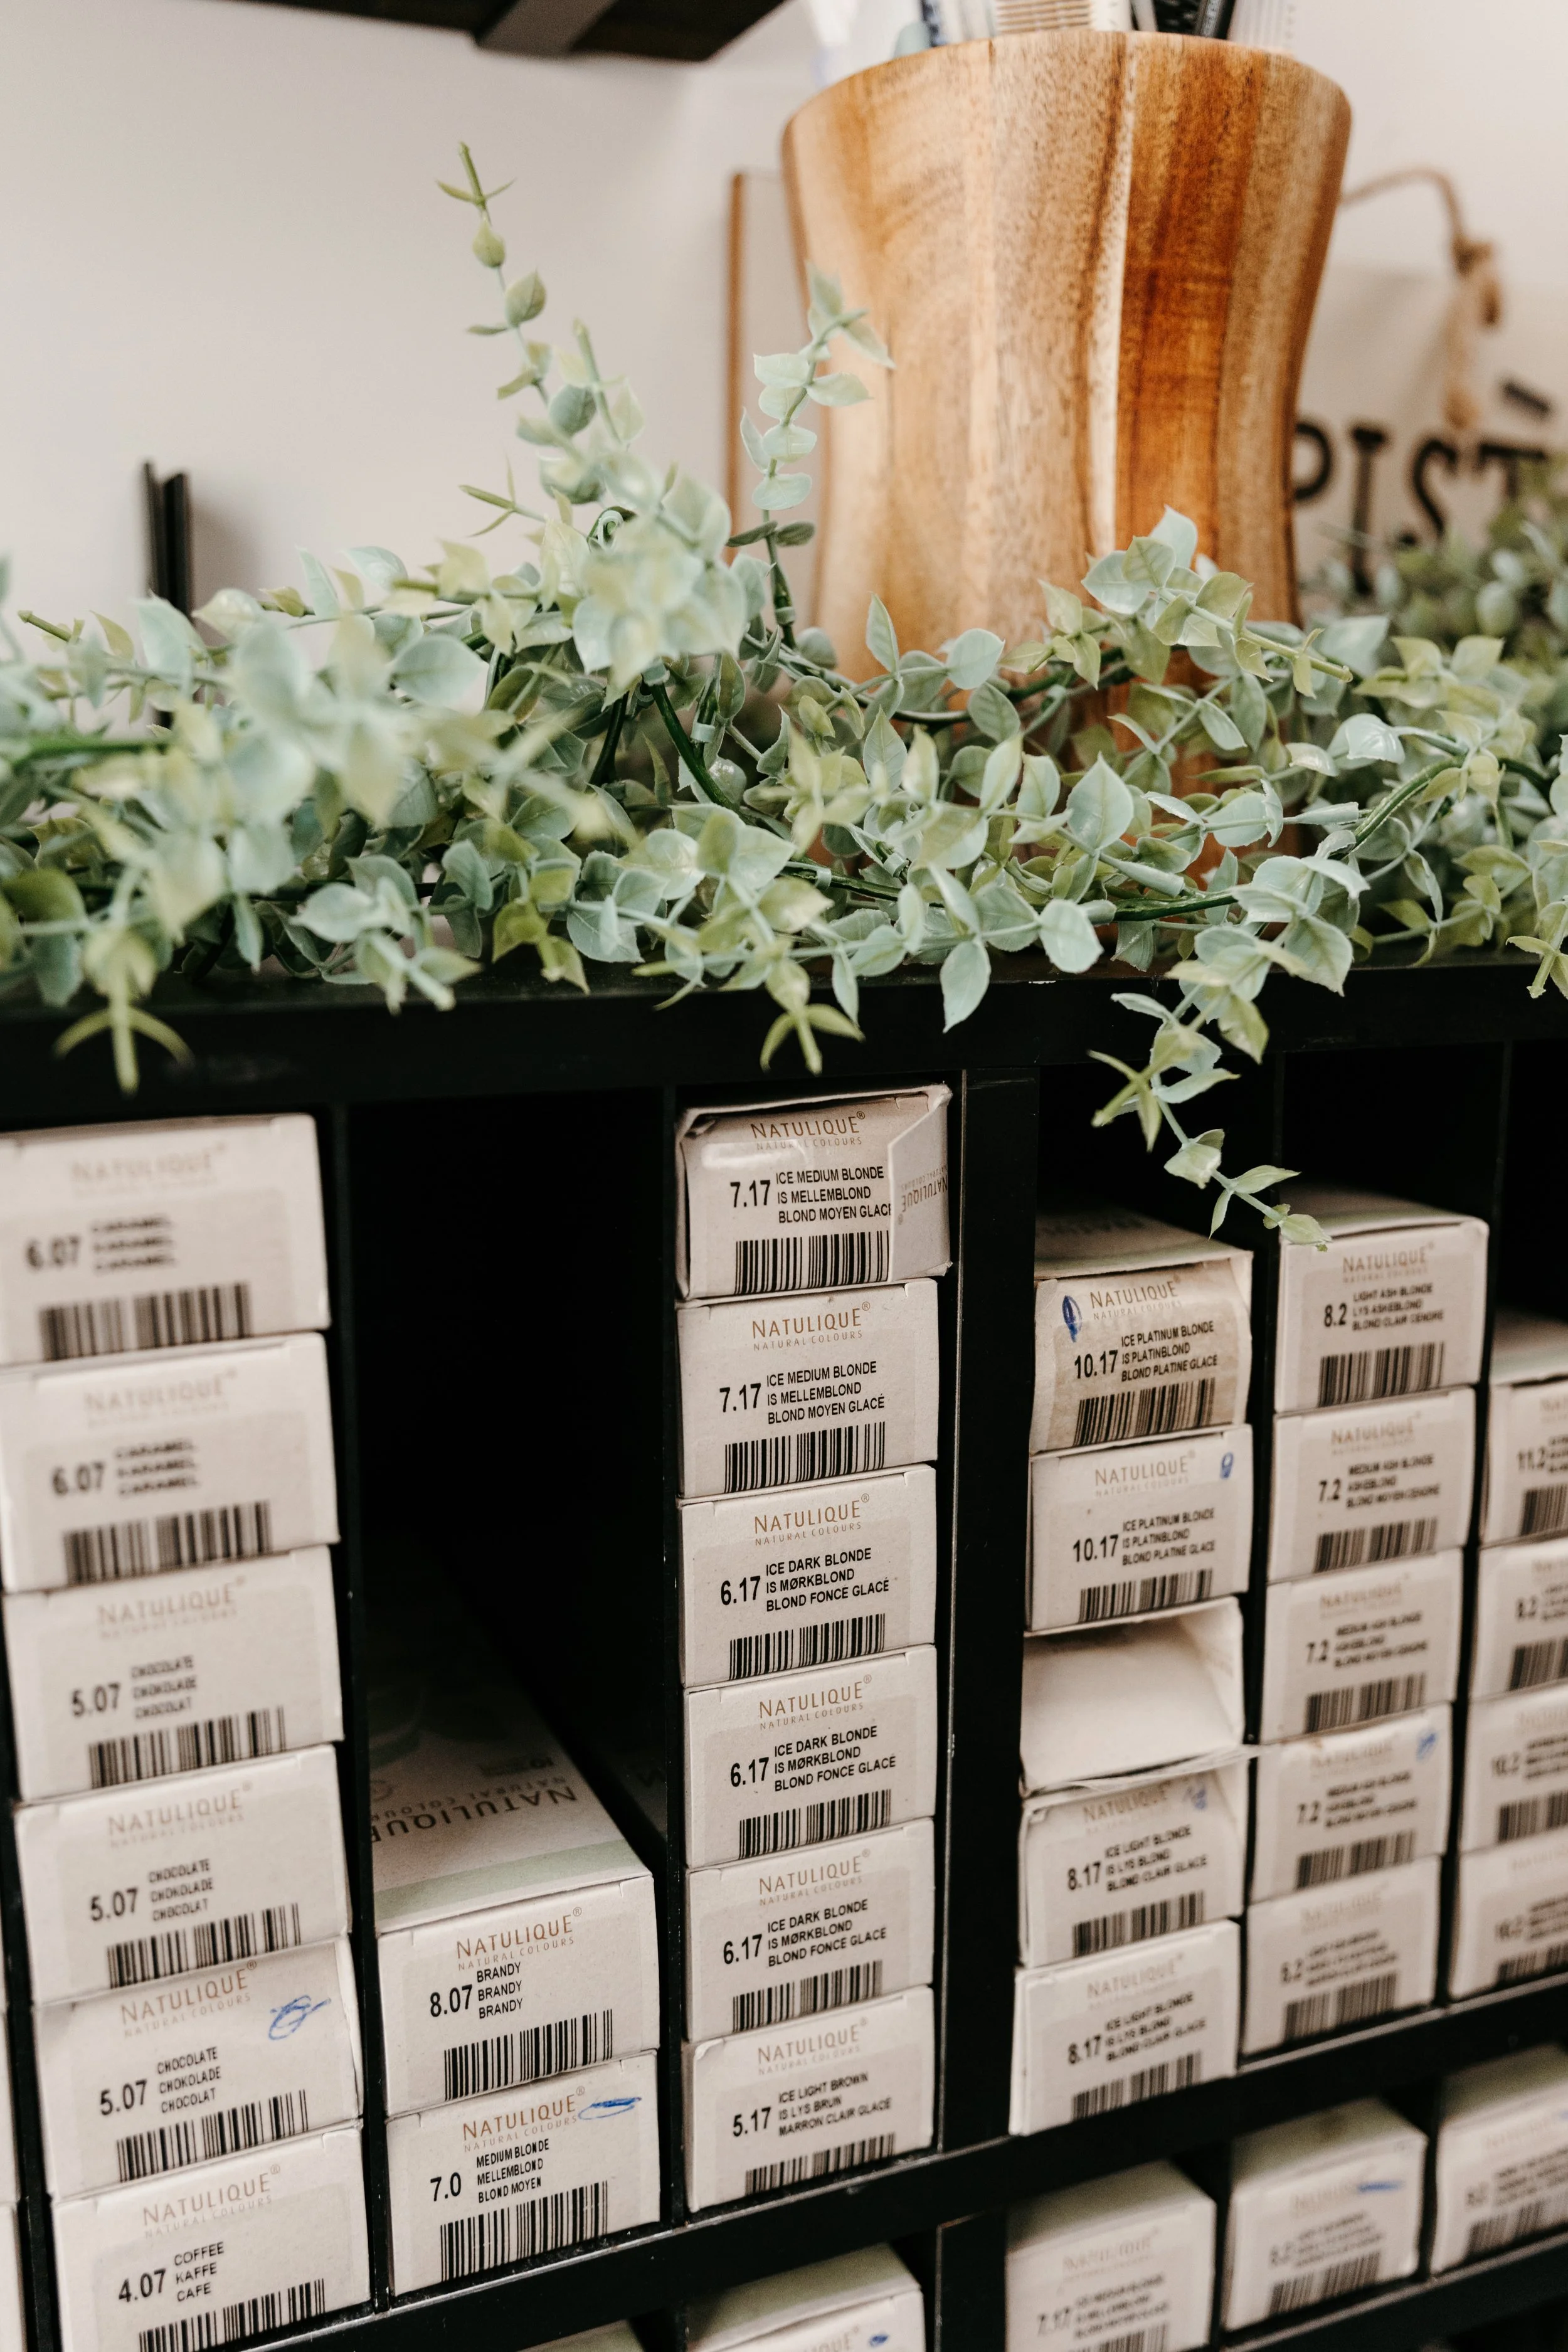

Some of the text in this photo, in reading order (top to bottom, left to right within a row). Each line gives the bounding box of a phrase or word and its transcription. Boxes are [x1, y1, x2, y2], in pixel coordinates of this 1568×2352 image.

[813, 1137, 862, 1147] COLOURS
[776, 1167, 884, 1185] ICE MEDIUM BLONDE
[730, 1180, 770, 1207] 7.17
[778, 1186, 871, 1204] IS MELLEMBLOND
[778, 1204, 890, 1223] BLOND MOYEN GLAC
[1324, 1303, 1347, 1327] 8.2
[754, 1330, 862, 1351] NATURAL COLOURS
[1121, 1321, 1214, 1347] ICE PLATINUM BLONDE
[1074, 1350, 1118, 1379] 10.17
[1123, 1342, 1190, 1364] IS PLATINBLOND
[767, 1361, 876, 1387] ICE MEDIUM BLONDE
[1121, 1367, 1150, 1382] BLOND
[1153, 1360, 1188, 1377] PLATINE
[719, 1383, 761, 1412] 7.17
[768, 1382, 861, 1406] IS MELLEMBLOND
[768, 1393, 884, 1424] BLOND MOYEN GLACÉ
[51, 1461, 105, 1496] 6.07
[1123, 1508, 1214, 1531] ICE PLATINUM BLONDE
[756, 1522, 861, 1545] NATURAL COLOURS
[766, 1548, 872, 1576] ICE DARK BLONDE
[1073, 1535, 1118, 1562] 10.17
[1123, 1550, 1150, 1565] BLOND
[721, 1576, 761, 1605] 6.17
[766, 1569, 854, 1594] IS MØRKBLOND
[766, 1592, 807, 1611] BLOND
[131, 1655, 194, 1680] CHOCOLATE
[72, 1682, 122, 1718] 5.07
[760, 1702, 864, 1730] NATURAL COLOURS
[775, 1726, 877, 1756] ICE DARK BLONDE
[731, 1757, 769, 1787] 6.17
[775, 1747, 861, 1774] IS MØRKBLOND
[775, 1773, 813, 1792] BLOND
[148, 1858, 210, 1883] CHOCOLATE
[1068, 1862, 1101, 1891] 8.17
[151, 1878, 213, 1903] CHOKOLADE
[760, 1890, 809, 1906] NATURAL
[90, 1887, 138, 1922] 5.07
[152, 1900, 208, 1922] CHOCOLAT
[768, 1899, 867, 1933] ICE DARK BLONDE
[768, 1920, 852, 1950] IS MØRKBLOND
[458, 1936, 575, 1971] NATURAL COLOURS
[723, 1934, 762, 1964] 6.17
[768, 1949, 807, 1966] BLOND
[477, 1962, 521, 1983] BRANDY
[430, 1984, 472, 2017] 8.07
[478, 1980, 522, 2001] BRANDY
[125, 1994, 251, 2037] NATURAL COLOURS
[479, 1998, 523, 2019] BRANDY
[157, 2046, 218, 2074] CHOCOLATE
[159, 2067, 221, 2094] CHOKOLADE
[779, 2072, 868, 2104] ICE LIGHT BROWN
[100, 2080, 147, 2116] 5.07
[161, 2088, 215, 2113] CHOCOLAT
[779, 2108, 788, 2120] IS
[791, 2103, 811, 2118] LYS
[464, 2115, 577, 2153] NATURAL COLOURS
[733, 2107, 772, 2137] 5.17
[779, 2116, 823, 2137] MARRON
[477, 2139, 549, 2168] MEDIUM BLONDE
[478, 2159, 543, 2186] MELLEMBLOND
[430, 2172, 462, 2201] 7.0
[479, 2176, 541, 2203] BLOND MOYEN
[145, 2196, 272, 2239] NATURAL COLOURS
[174, 2242, 224, 2267] COFFEE
[118, 2269, 166, 2304] 4.07
[176, 2262, 216, 2285] KAFFE
[177, 2282, 211, 2302] CAFE
